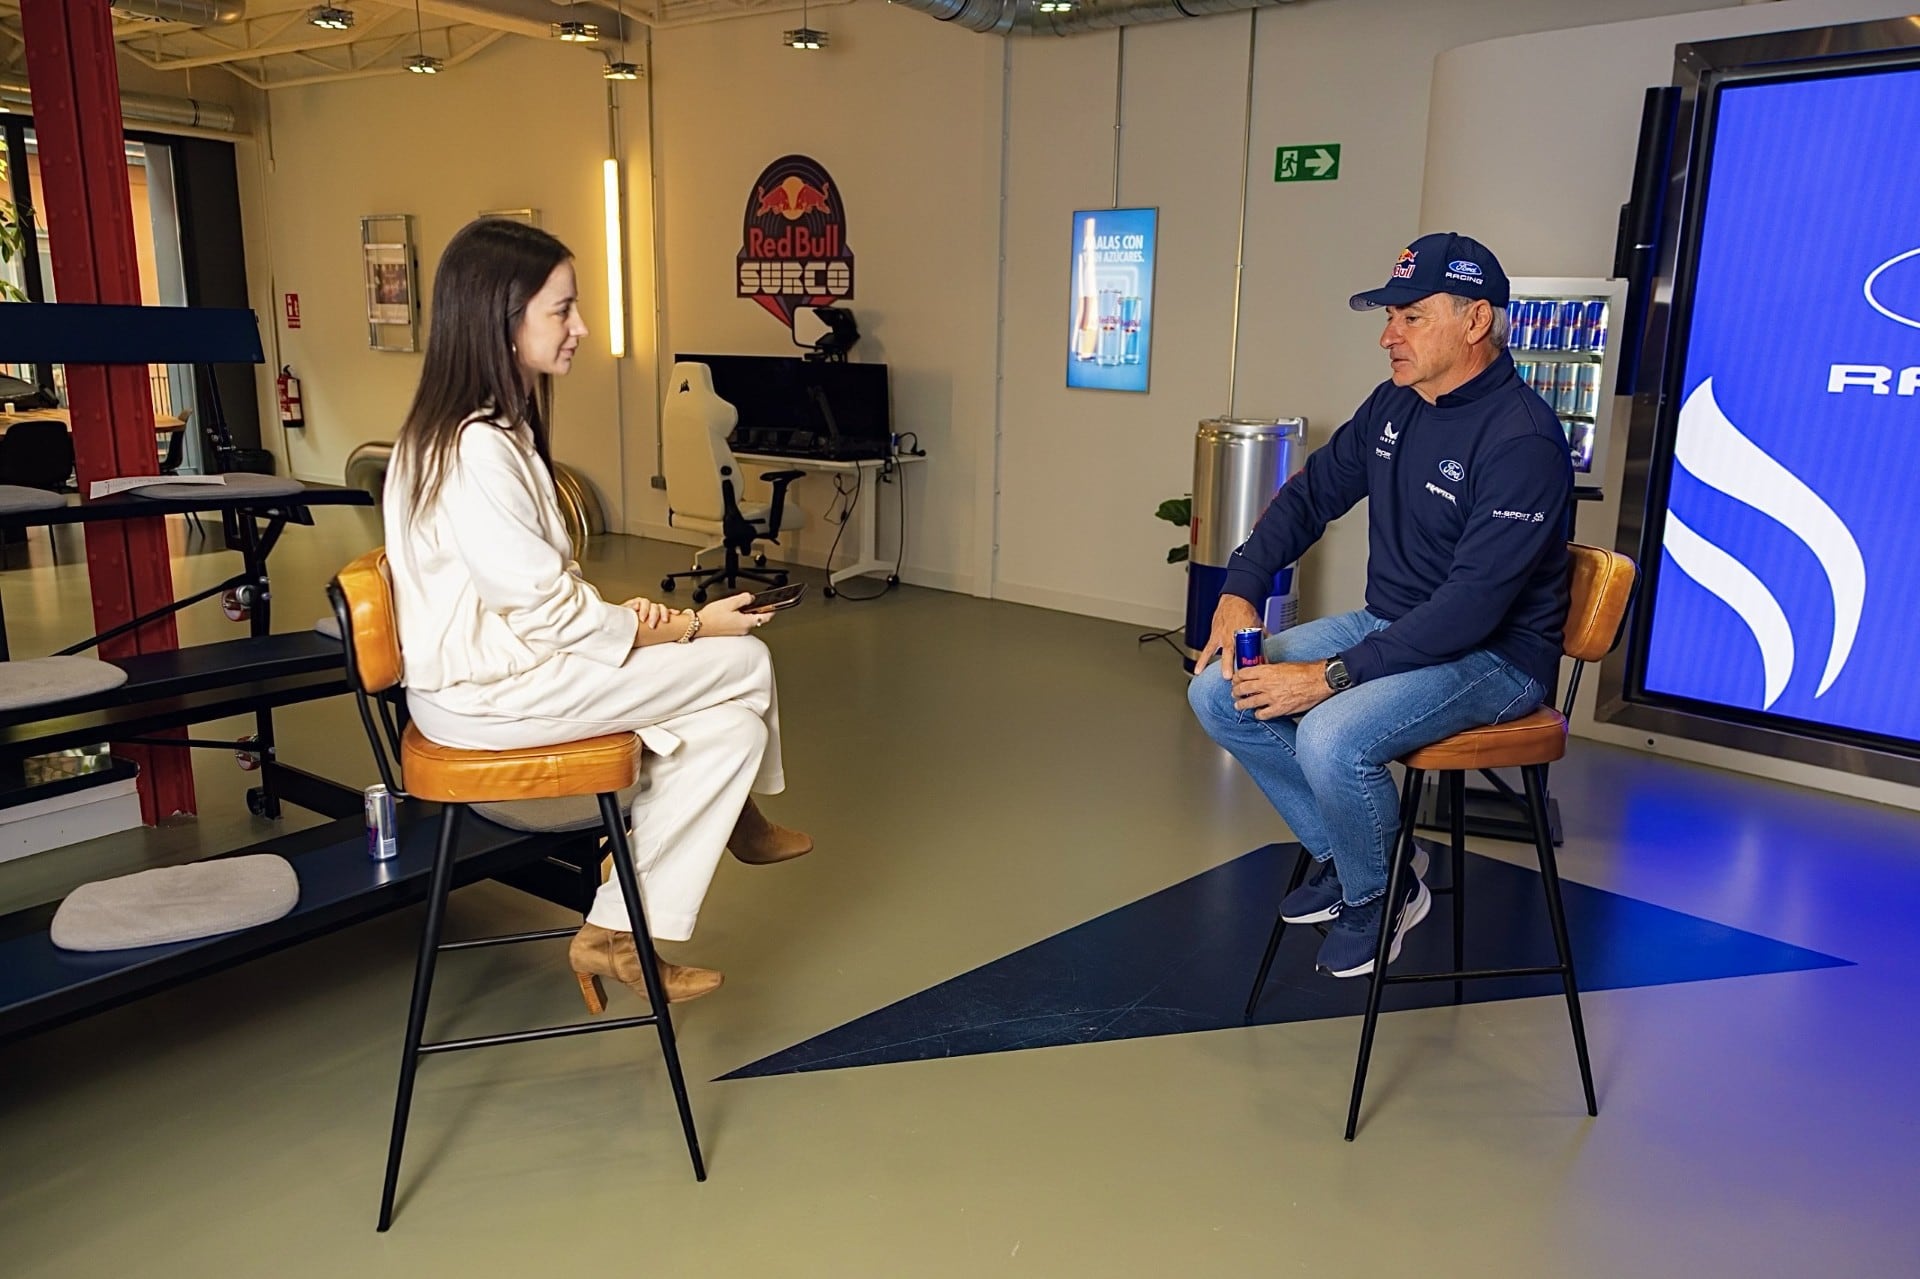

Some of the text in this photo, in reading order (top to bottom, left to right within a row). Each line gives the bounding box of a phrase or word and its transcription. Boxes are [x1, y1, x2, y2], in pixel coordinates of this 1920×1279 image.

[750, 224, 839, 257] Red Bull
[1122, 235, 1144, 249] CON
[1455, 261, 1477, 273] Ford
[740, 262, 849, 294] SURCO
[1445, 272, 1483, 285] RACING
[1443, 462, 1460, 480] Ford
[1242, 655, 1259, 665] Red
